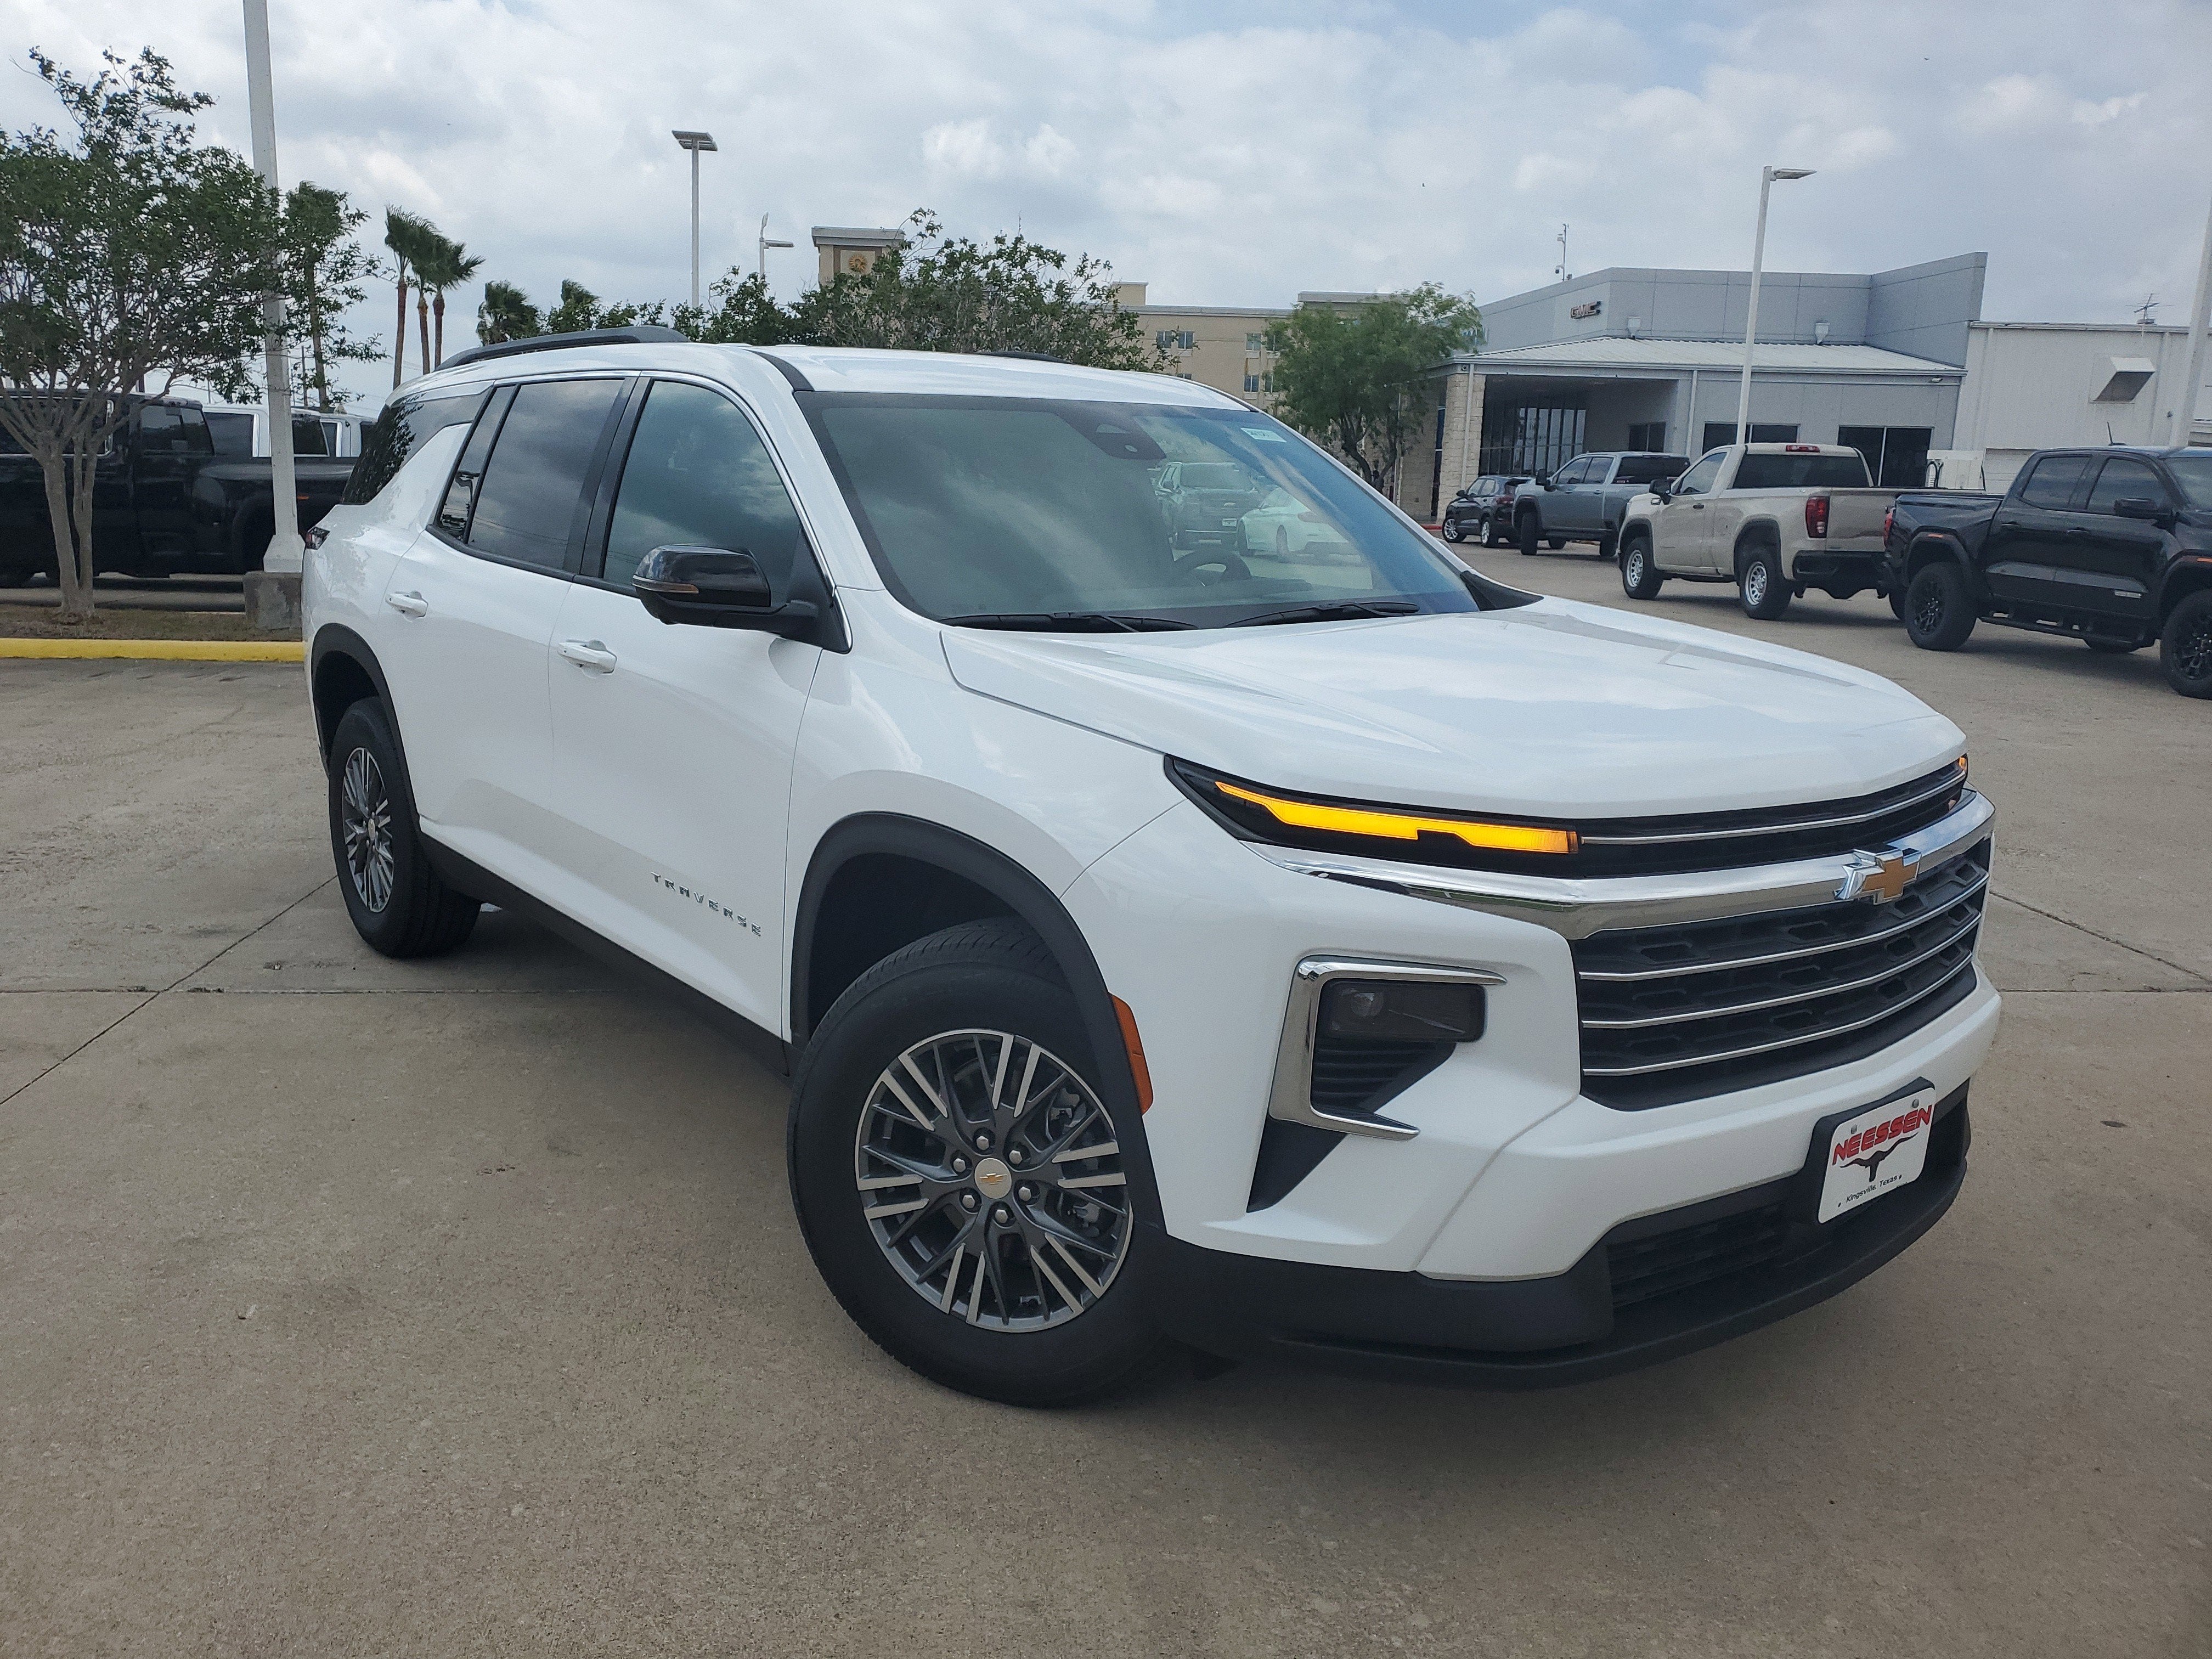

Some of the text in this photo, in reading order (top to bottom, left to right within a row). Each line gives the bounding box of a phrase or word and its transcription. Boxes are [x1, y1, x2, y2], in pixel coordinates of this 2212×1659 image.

[1570, 301, 1601, 319] GMC
[651, 871, 761, 937] TRAVERSE
[1832, 1104, 1933, 1165] NEESSEN
[1879, 1175, 1898, 1187] Texas
